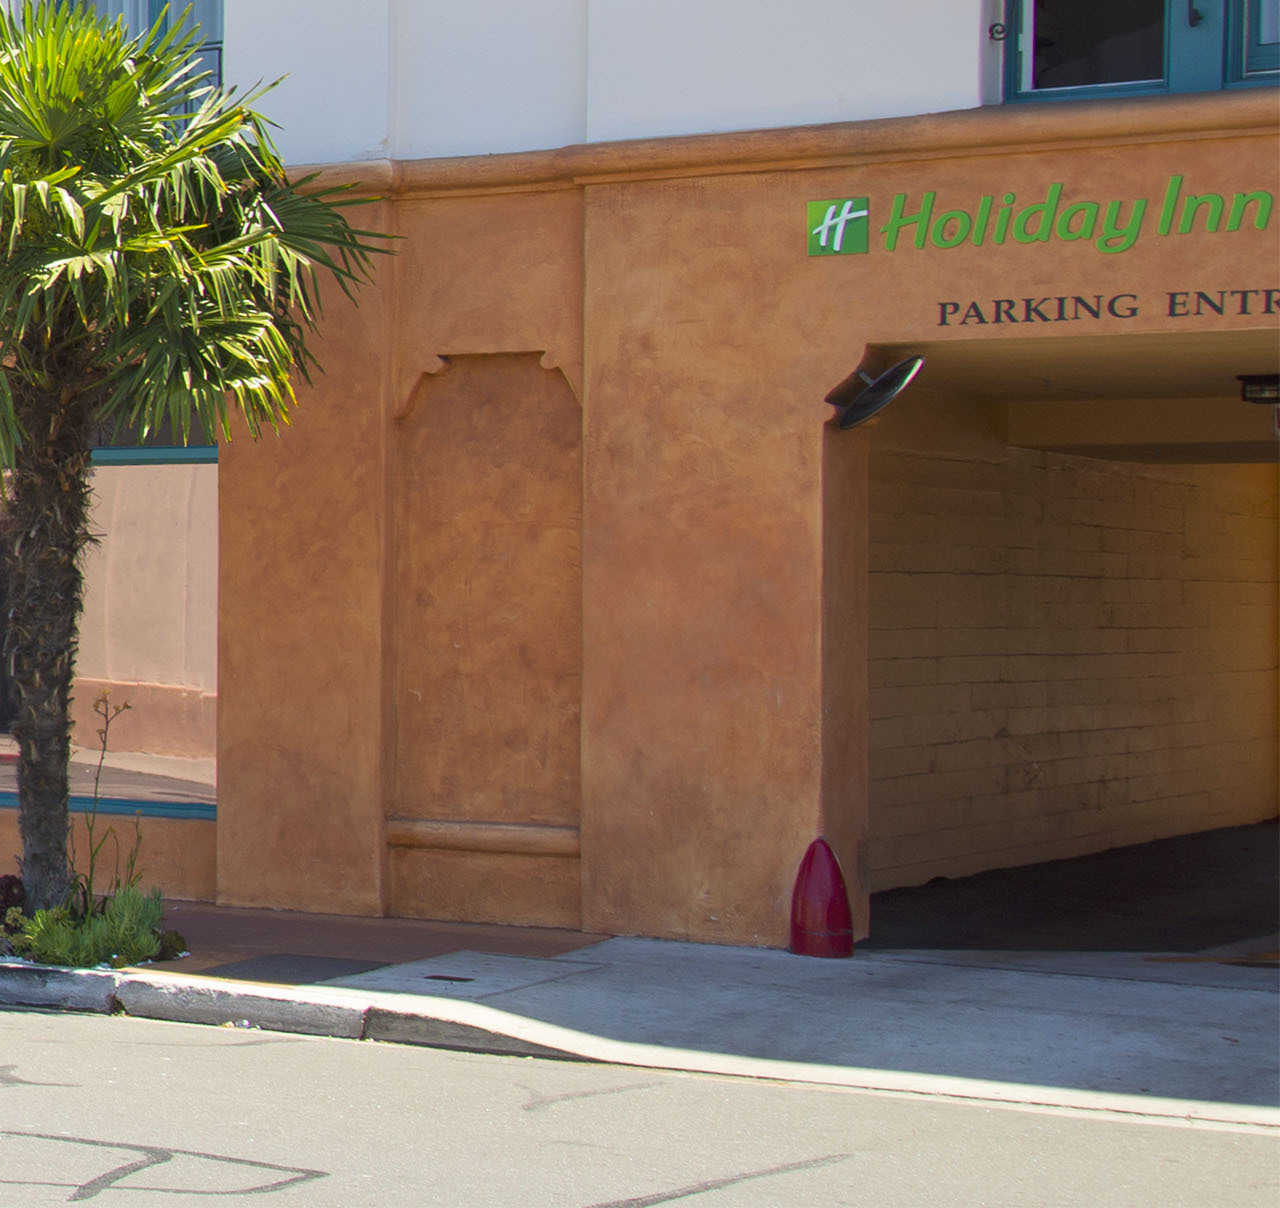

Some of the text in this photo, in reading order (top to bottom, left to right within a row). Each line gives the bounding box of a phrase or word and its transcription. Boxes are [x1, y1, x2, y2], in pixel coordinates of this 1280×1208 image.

[880, 182, 1148, 254] Holiday
[1157, 175, 1273, 236] Inn
[936, 293, 1140, 326] PARKING
